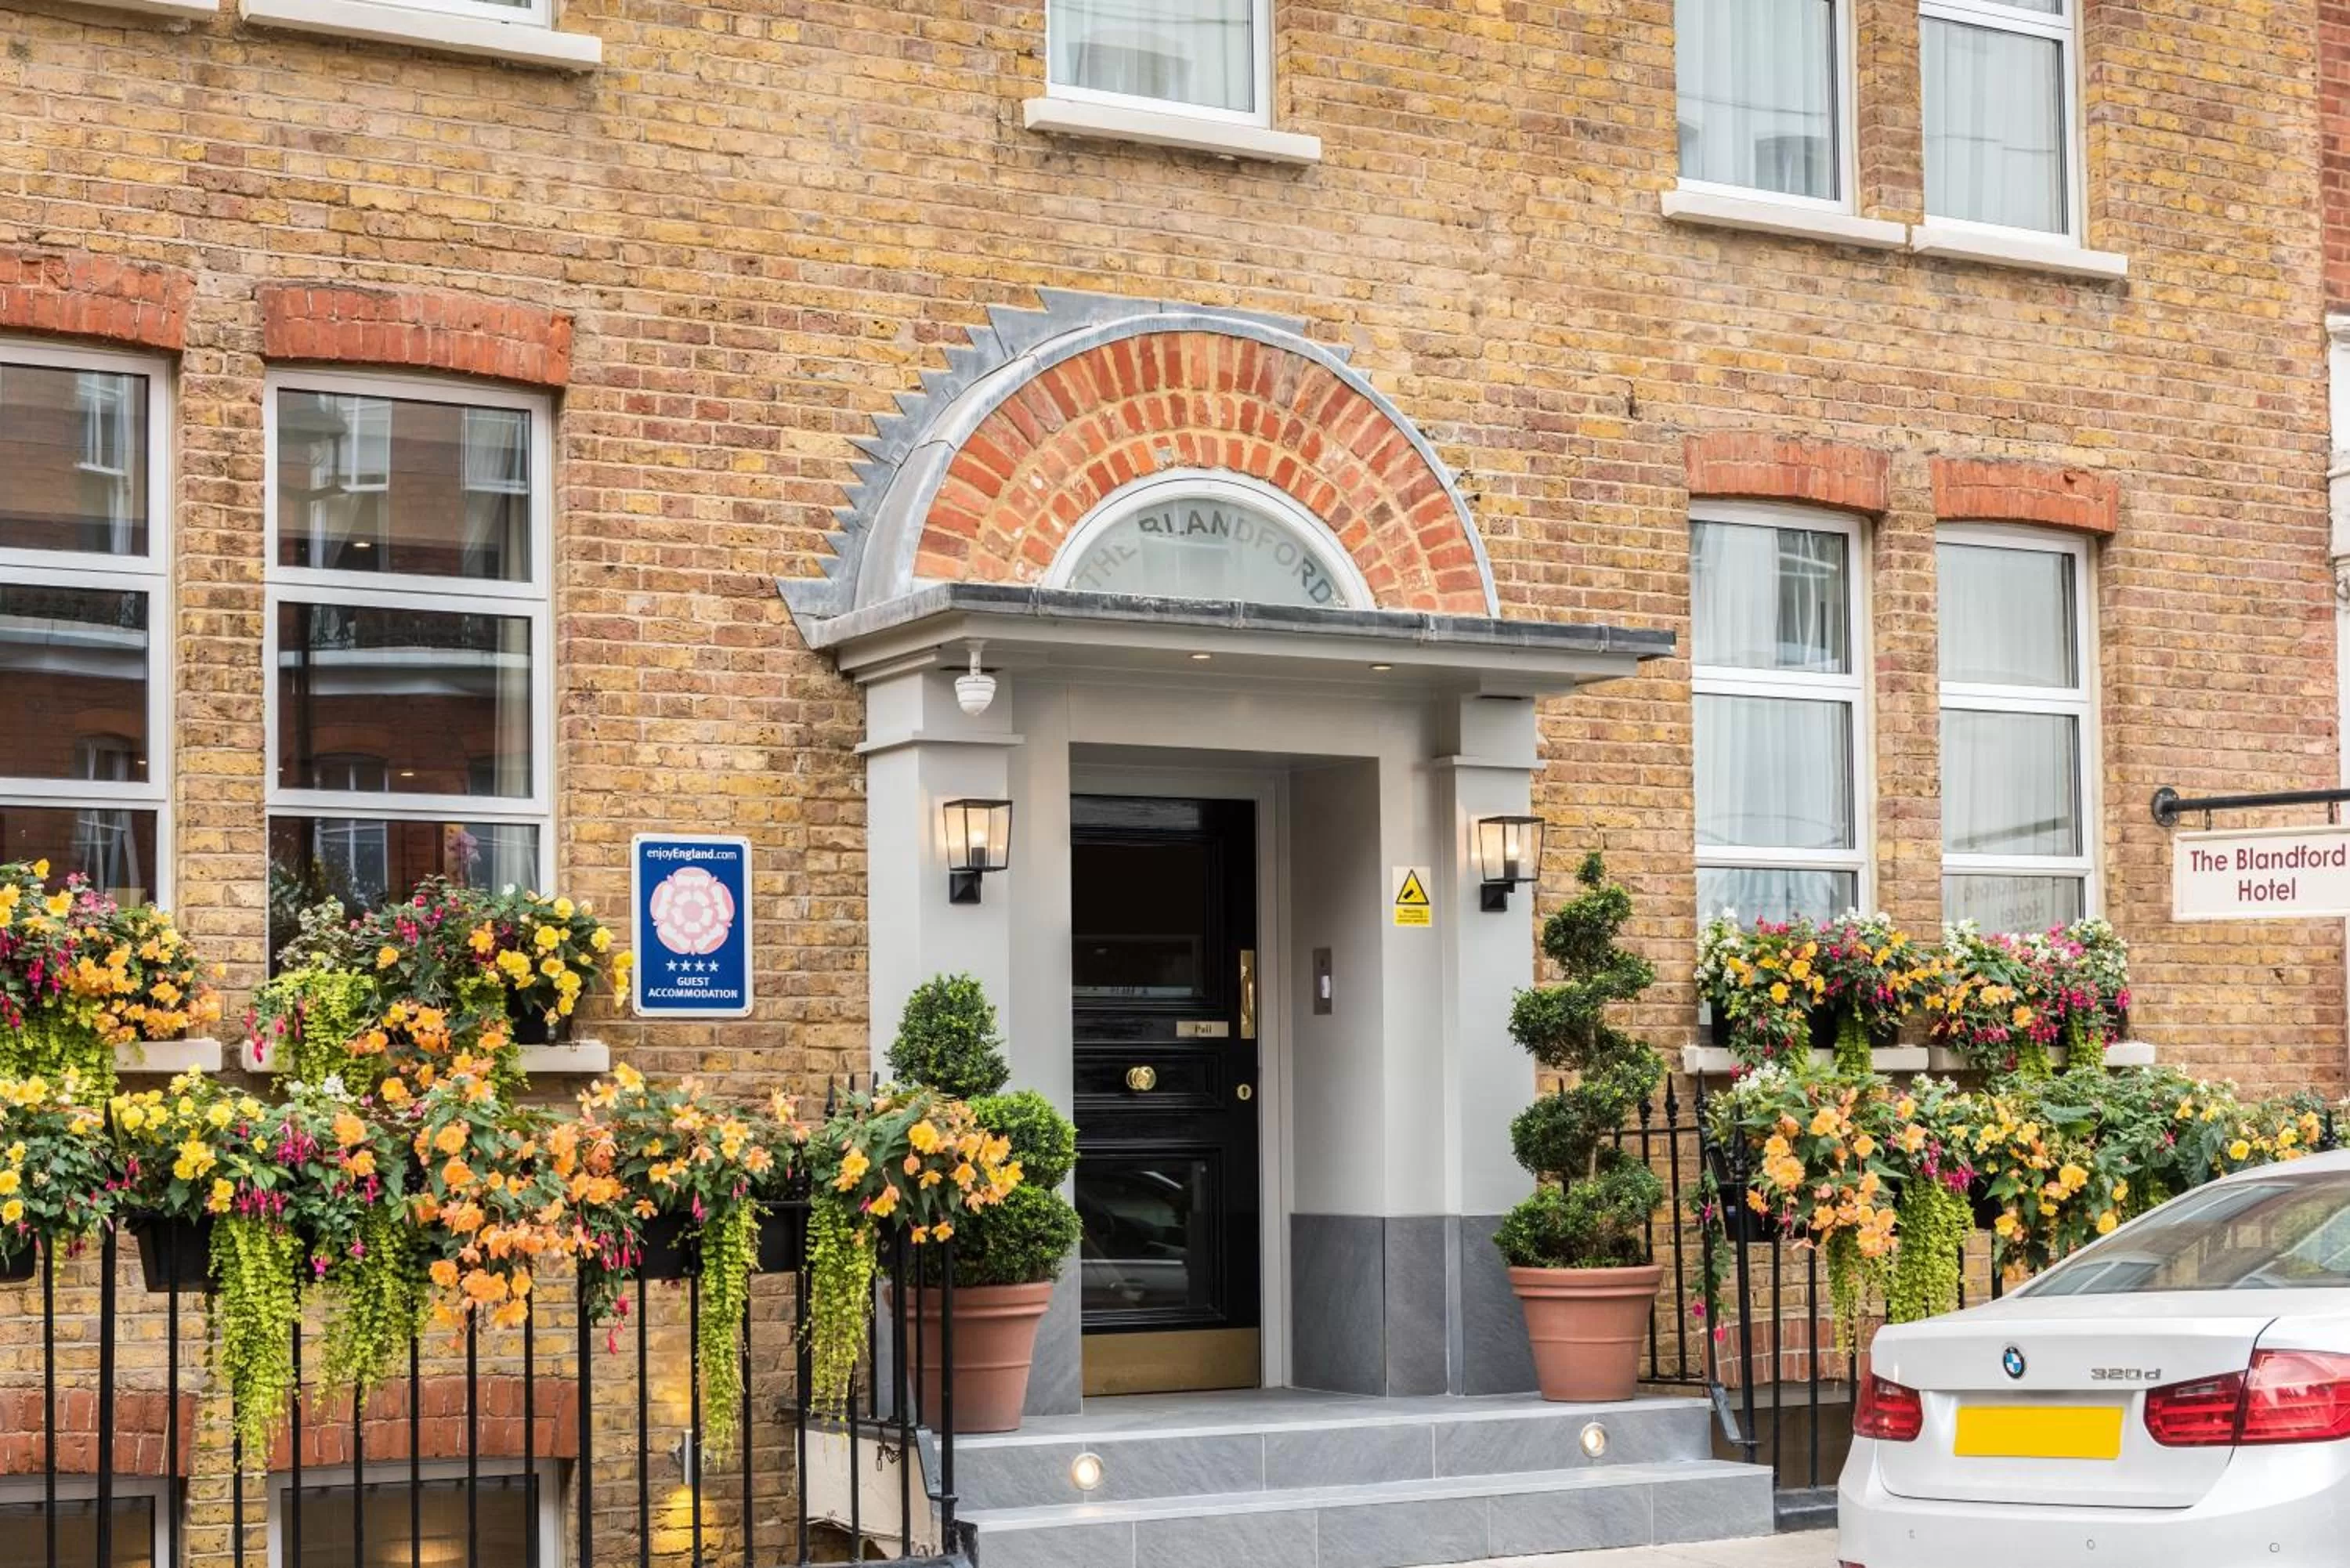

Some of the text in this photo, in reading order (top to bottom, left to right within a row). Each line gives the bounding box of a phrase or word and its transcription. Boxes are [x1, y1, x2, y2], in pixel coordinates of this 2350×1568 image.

[1078, 510, 1332, 603] THE BLANDFORD
[646, 847, 737, 861] enjoyEngland.com
[2190, 843, 2347, 872] The Blandford
[2238, 877, 2297, 901] Hotel
[677, 977, 710, 986] GUEST
[648, 988, 738, 999] ACCOMMODATION
